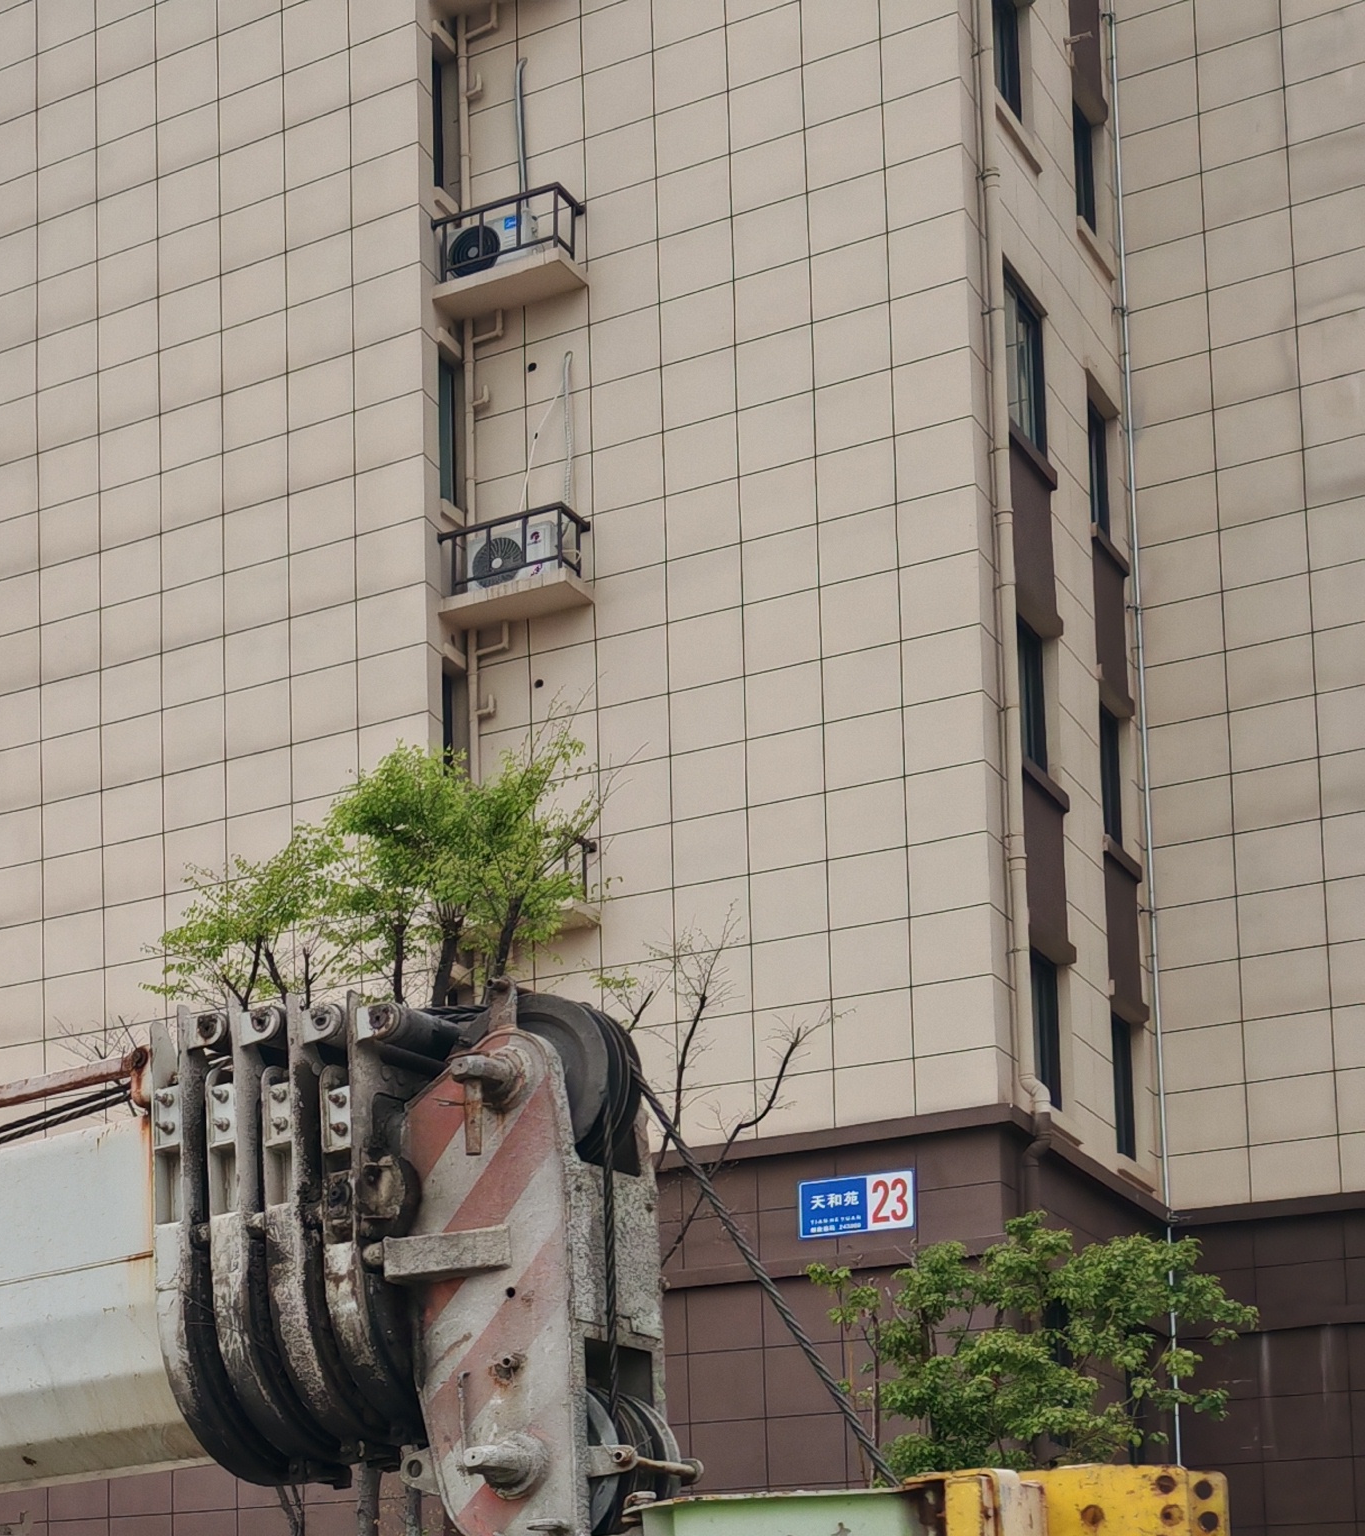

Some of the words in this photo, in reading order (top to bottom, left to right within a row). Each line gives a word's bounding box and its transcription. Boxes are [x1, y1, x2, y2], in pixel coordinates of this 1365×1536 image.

[810, 1191, 859, 1210] 天和苑
[871, 1177, 909, 1224] 23
